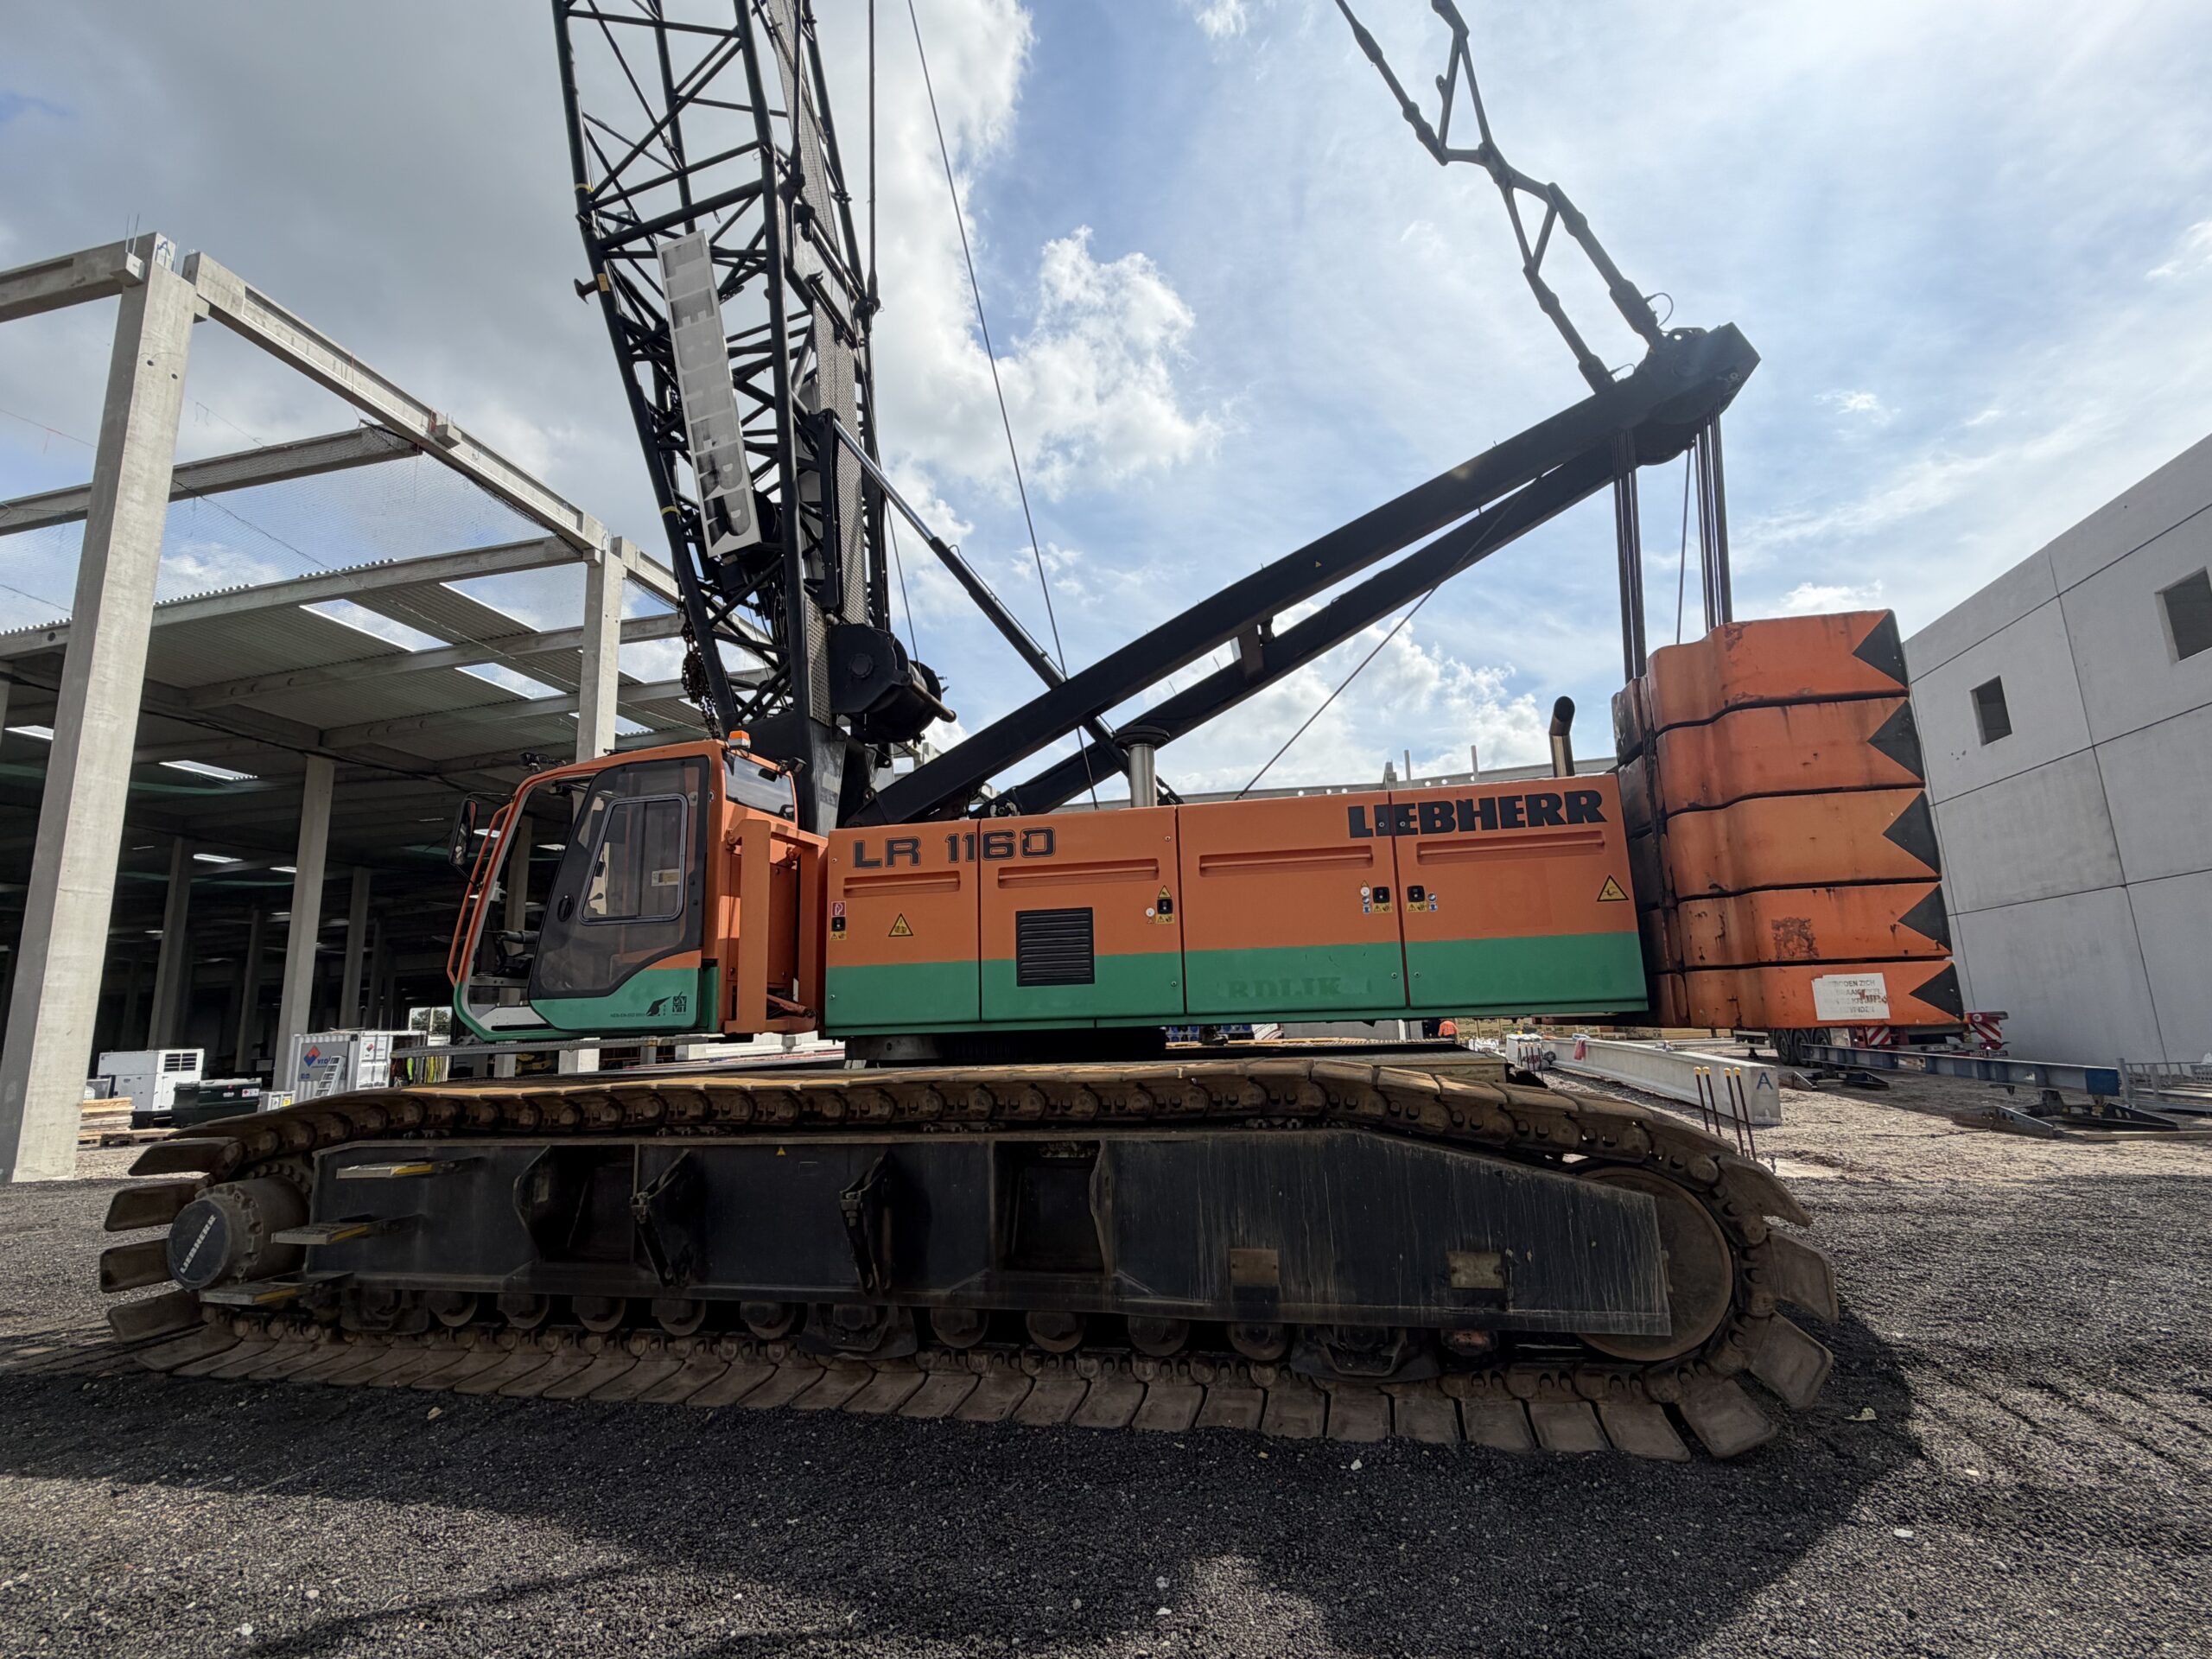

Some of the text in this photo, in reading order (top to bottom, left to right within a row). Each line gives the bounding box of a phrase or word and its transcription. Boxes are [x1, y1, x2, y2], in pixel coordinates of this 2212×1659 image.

[662, 238, 752, 546] LIEBHERR
[1347, 790, 1608, 838] LIEBHERR
[852, 826, 1057, 869] LR 1160
[1757, 1071, 1773, 1090] A
[179, 1214, 217, 1274] LIEBHERR
